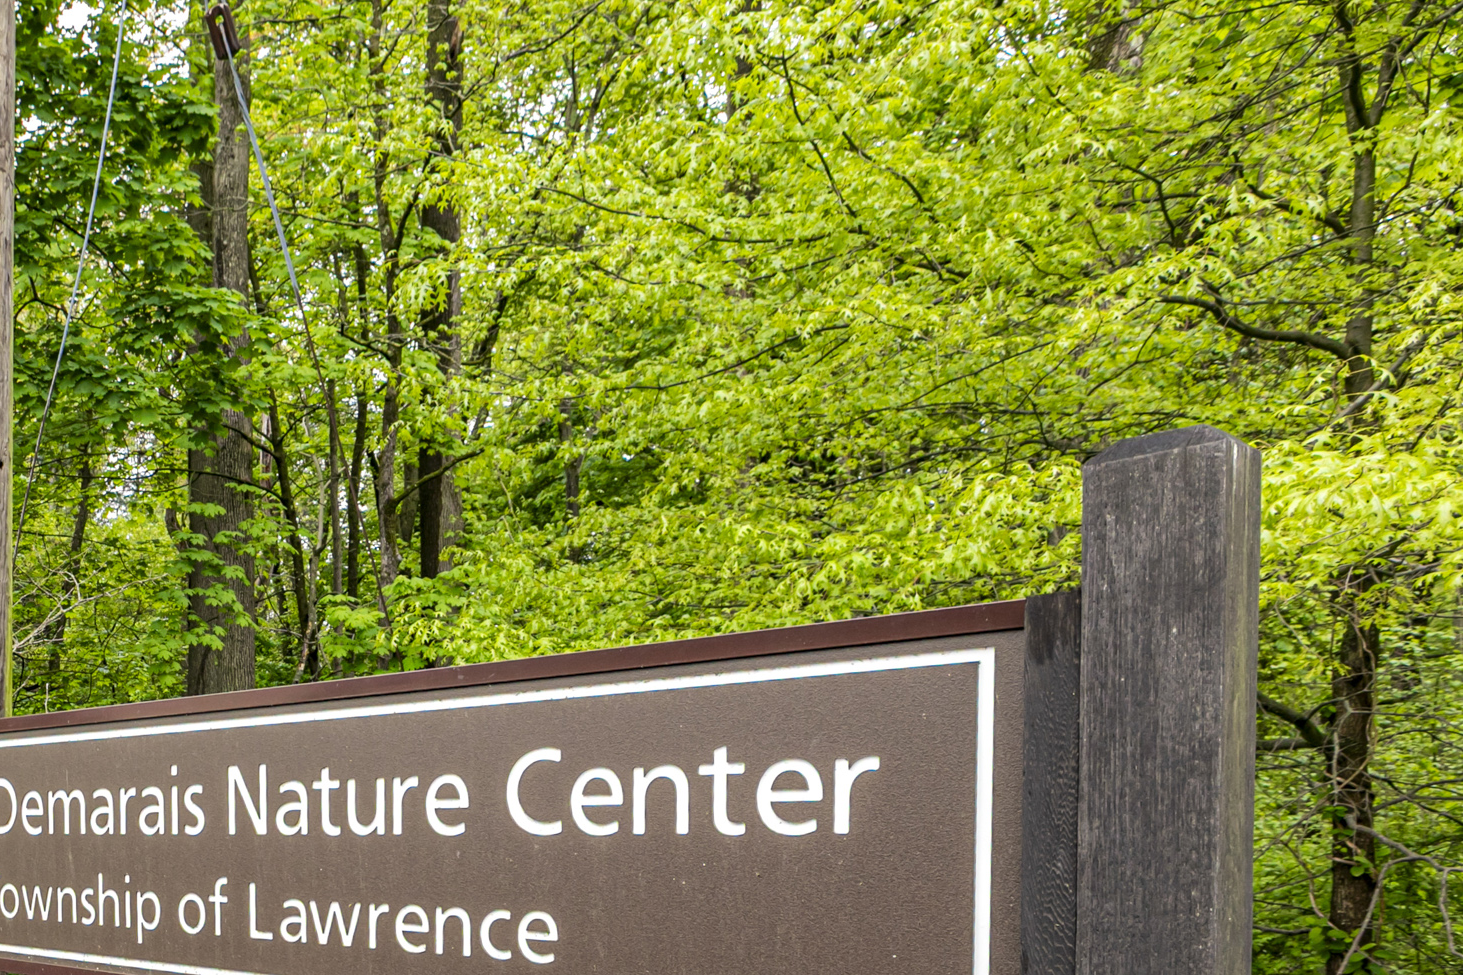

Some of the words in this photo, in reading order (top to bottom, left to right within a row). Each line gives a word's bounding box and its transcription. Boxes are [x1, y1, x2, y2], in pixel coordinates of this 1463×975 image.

[227, 763, 470, 837] Nature
[505, 746, 881, 837] Center
[177, 876, 229, 936] of
[248, 882, 559, 965] Lawrence
